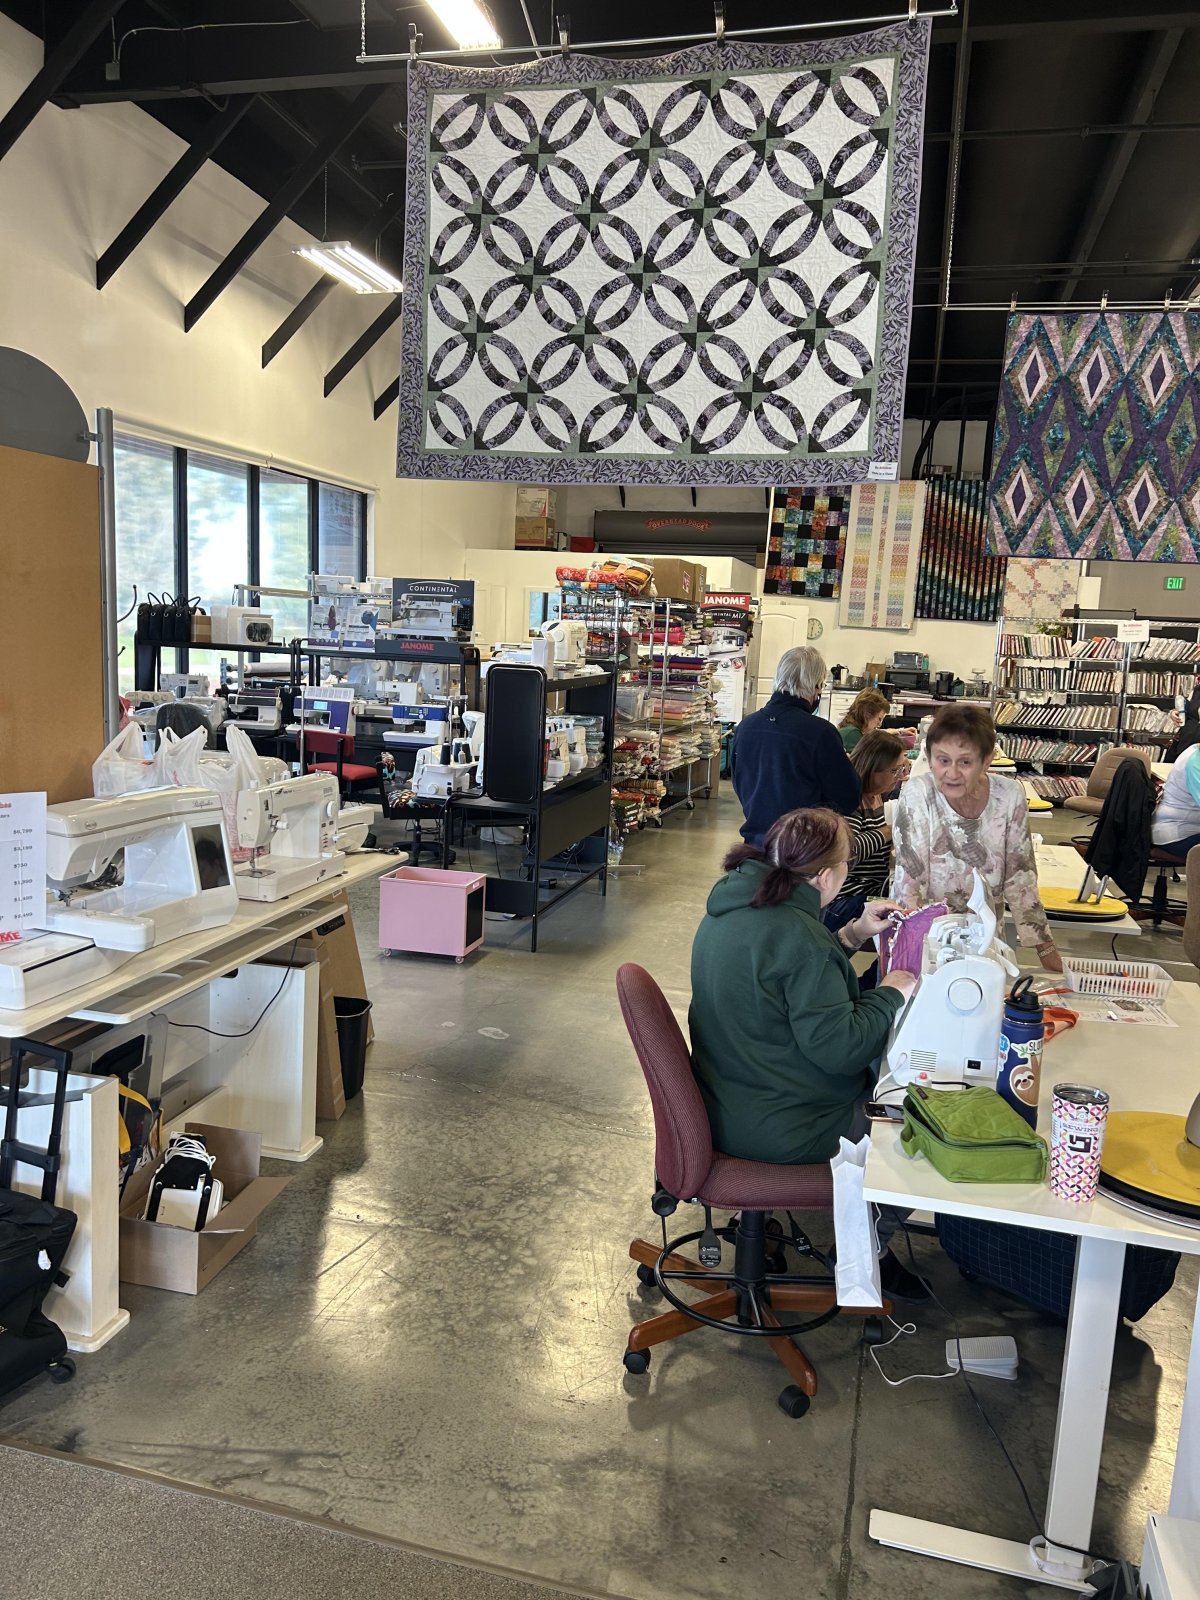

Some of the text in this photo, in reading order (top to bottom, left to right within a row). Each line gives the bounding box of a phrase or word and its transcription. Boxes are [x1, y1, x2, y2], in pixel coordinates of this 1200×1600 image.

[1167, 577, 1184, 589] EXIT
[409, 585, 458, 593] CONTINENTAL
[704, 595, 746, 605] JANOME
[400, 642, 434, 651] JANOME
[1063, 1122, 1099, 1132] SEWING
